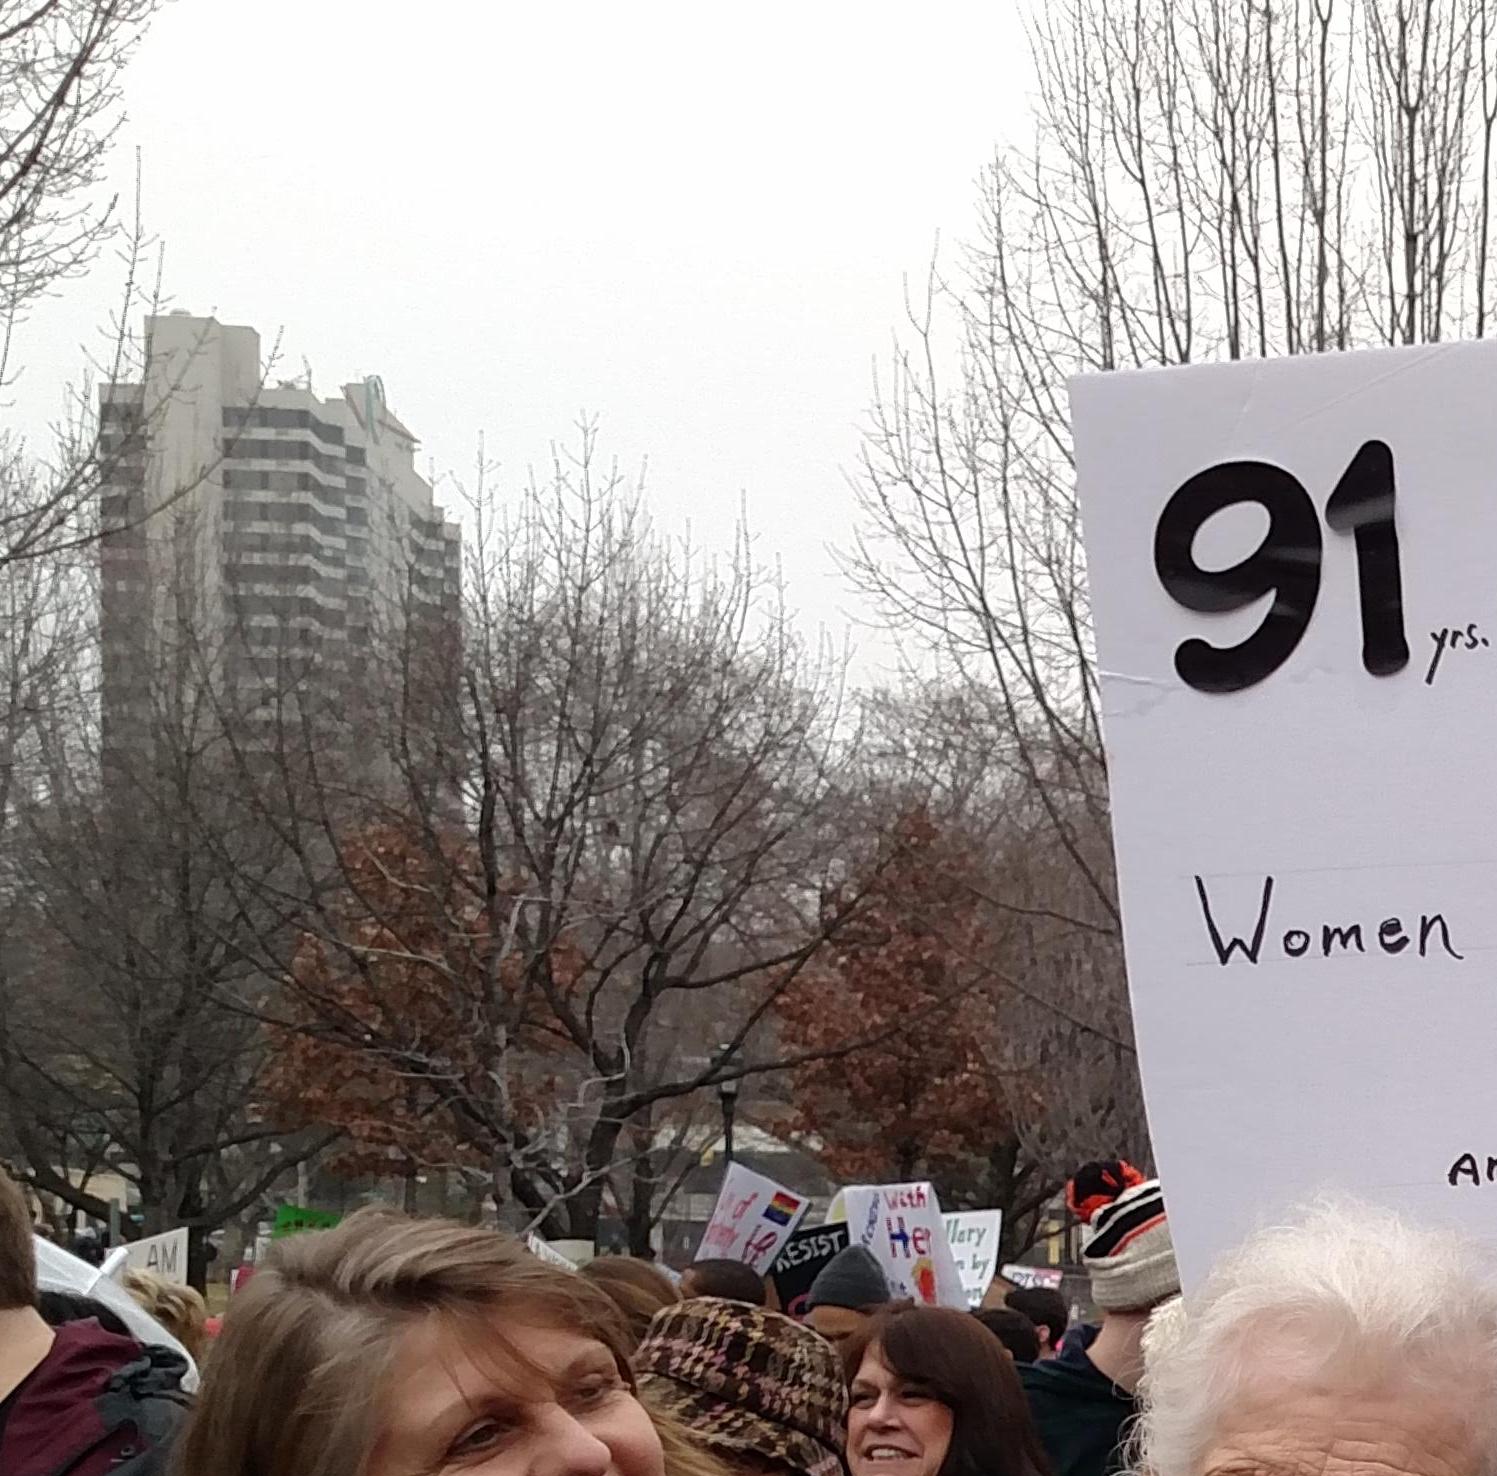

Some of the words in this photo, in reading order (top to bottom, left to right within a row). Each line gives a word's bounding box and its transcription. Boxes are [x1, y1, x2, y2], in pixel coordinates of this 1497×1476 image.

[1154, 440, 1411, 694] 91
[1424, 622, 1490, 685] yrs.
[1194, 875, 1464, 966] Women
[146, 1240, 179, 1274] AM
